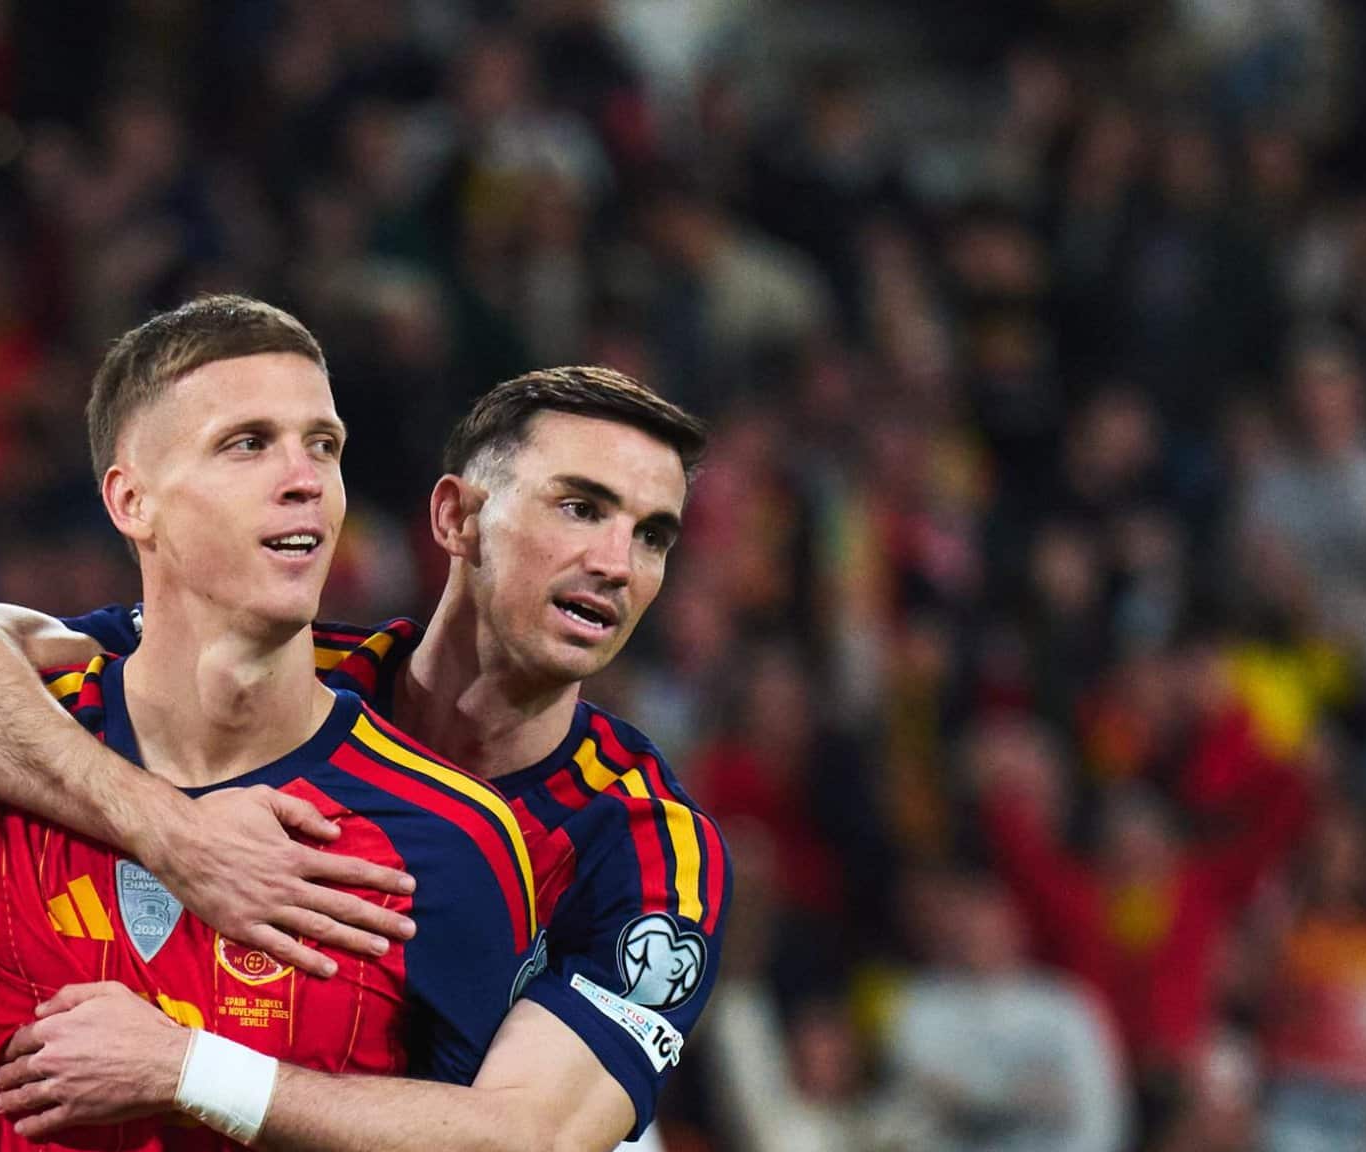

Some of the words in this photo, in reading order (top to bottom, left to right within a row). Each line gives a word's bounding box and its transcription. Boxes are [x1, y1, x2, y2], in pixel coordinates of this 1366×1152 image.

[135, 924, 164, 937] 2024
[225, 997, 247, 1006] SPAIN
[255, 999, 283, 1009] TURKEY
[228, 1007, 269, 1018] NOVEMBER
[240, 1017, 269, 1028] SEVILLE
